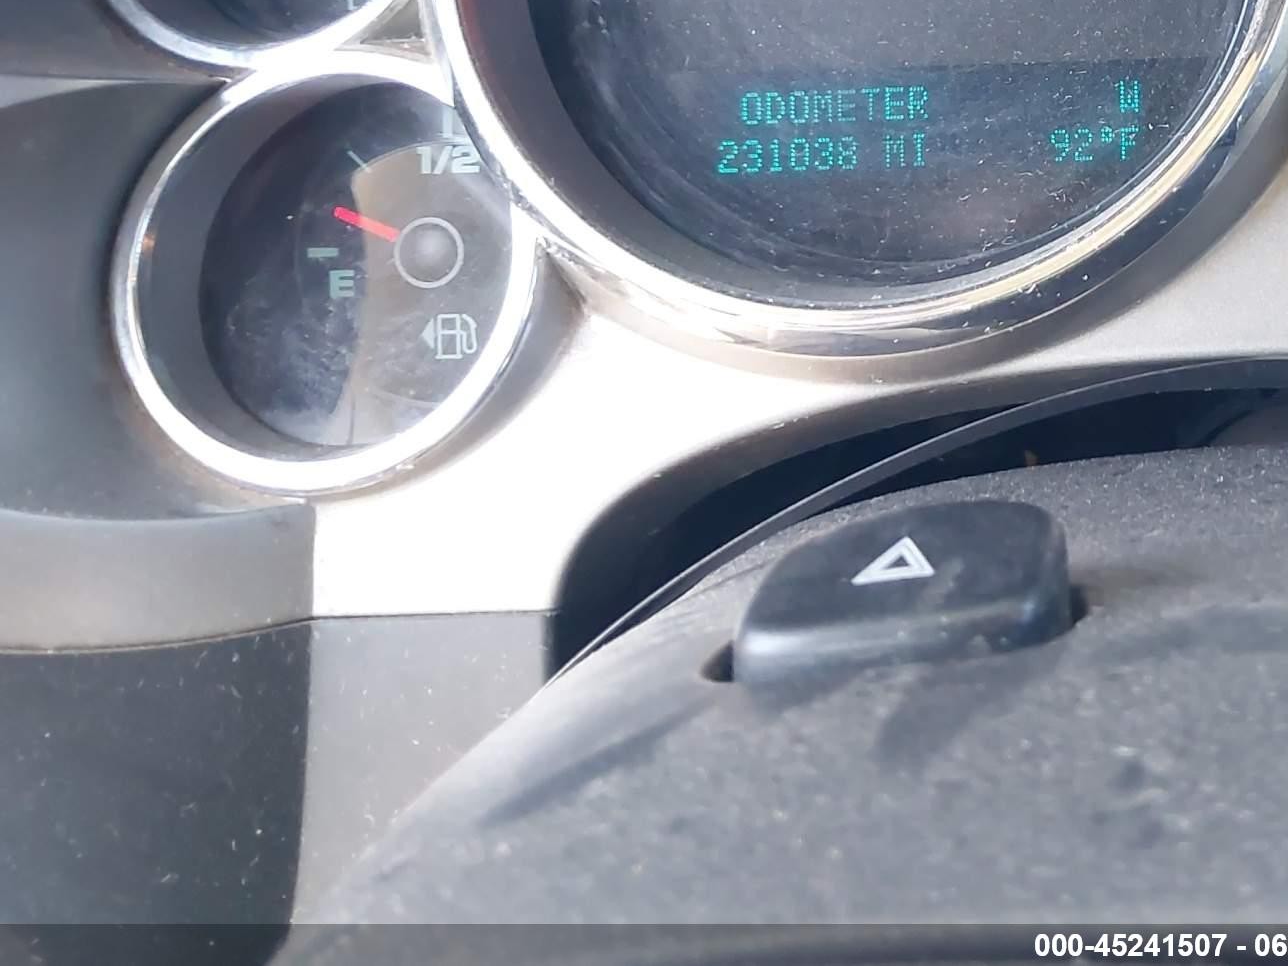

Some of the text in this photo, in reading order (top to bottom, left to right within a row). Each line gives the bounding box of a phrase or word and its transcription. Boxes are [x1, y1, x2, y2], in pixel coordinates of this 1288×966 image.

[740, 85, 929, 125] ODOMETER
[417, 146, 481, 174] 1/2
[717, 132, 926, 174] 231038 MI
[1050, 125, 1139, 162] 92°F
[330, 270, 354, 298] E
